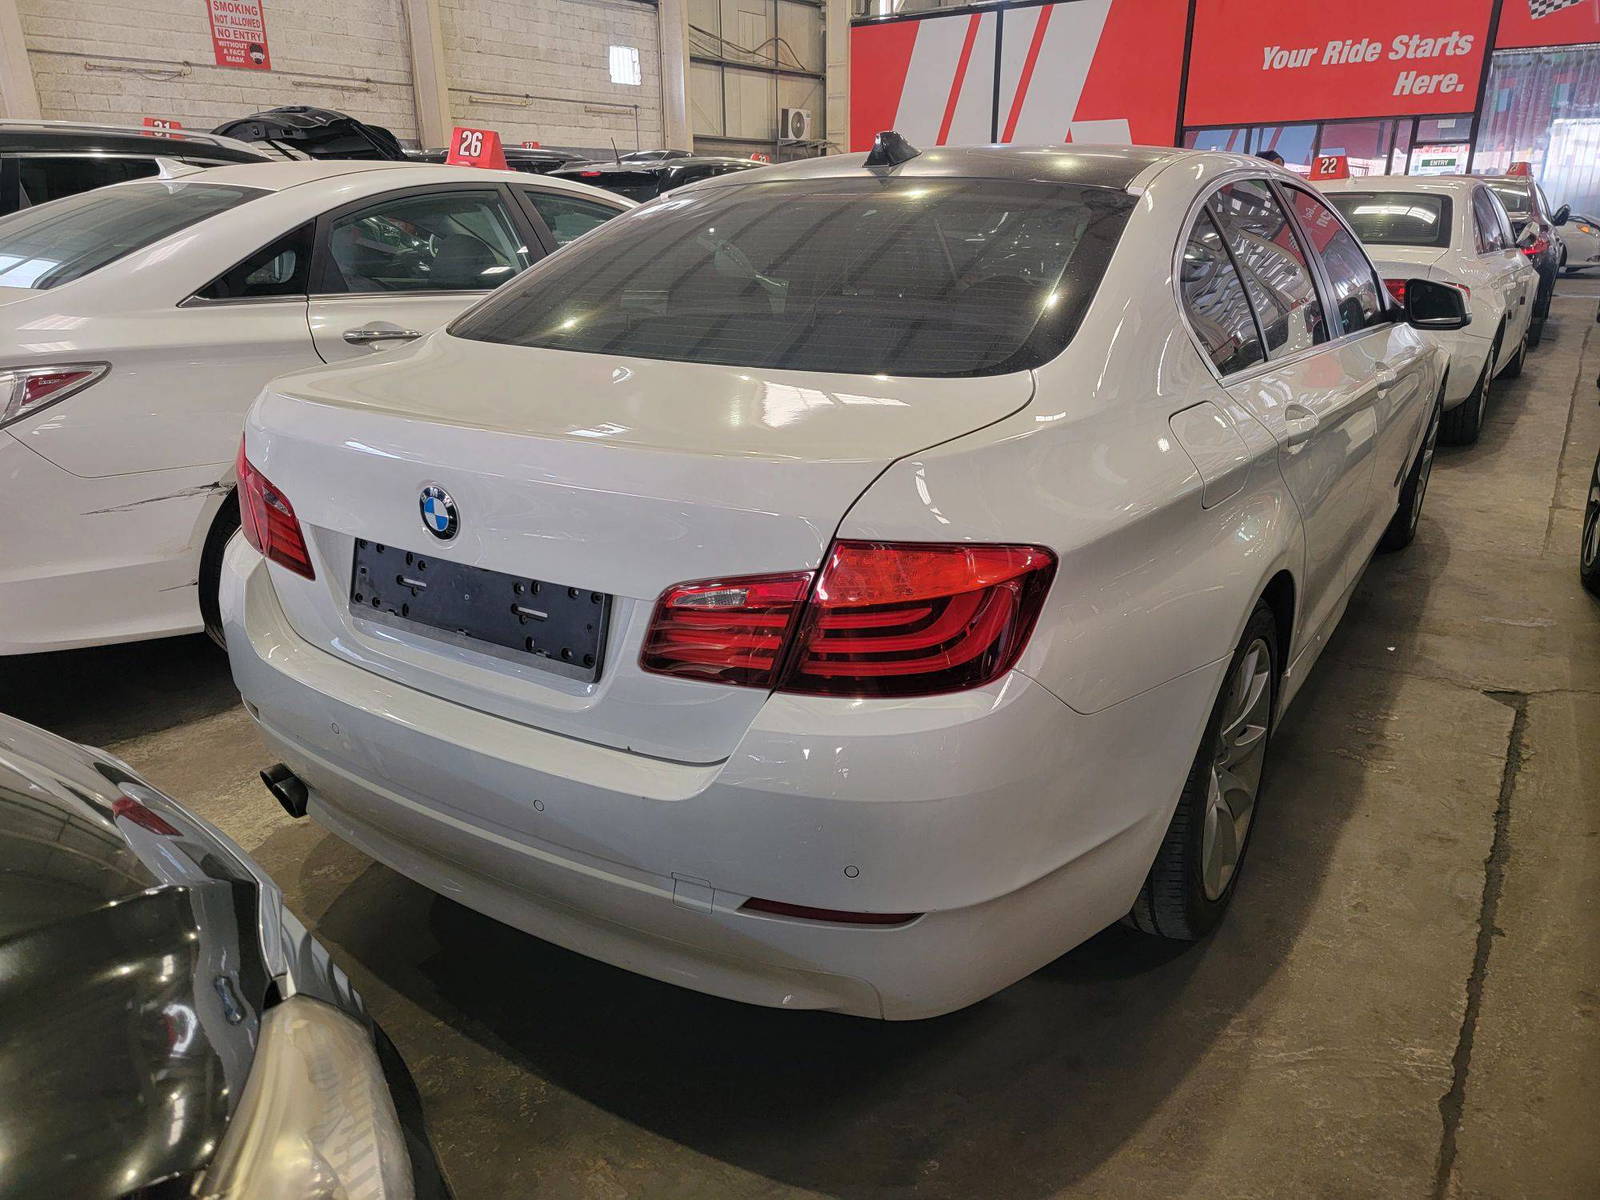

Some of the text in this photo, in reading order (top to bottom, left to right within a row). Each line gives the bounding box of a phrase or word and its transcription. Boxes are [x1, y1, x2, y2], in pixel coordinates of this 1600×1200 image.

[213, 1, 258, 16] SMOKING
[214, 14, 261, 28] NOT ALLOWED
[217, 28, 262, 41] NO ENTRY
[218, 40, 248, 49] WITHOUT
[1262, 31, 1475, 70] Your Ride Starts
[226, 55, 245, 63] MASK
[229, 49, 245, 57] FACE
[1392, 71, 1465, 96] Here.
[459, 130, 483, 157] 26
[1320, 157, 1337, 174] 22
